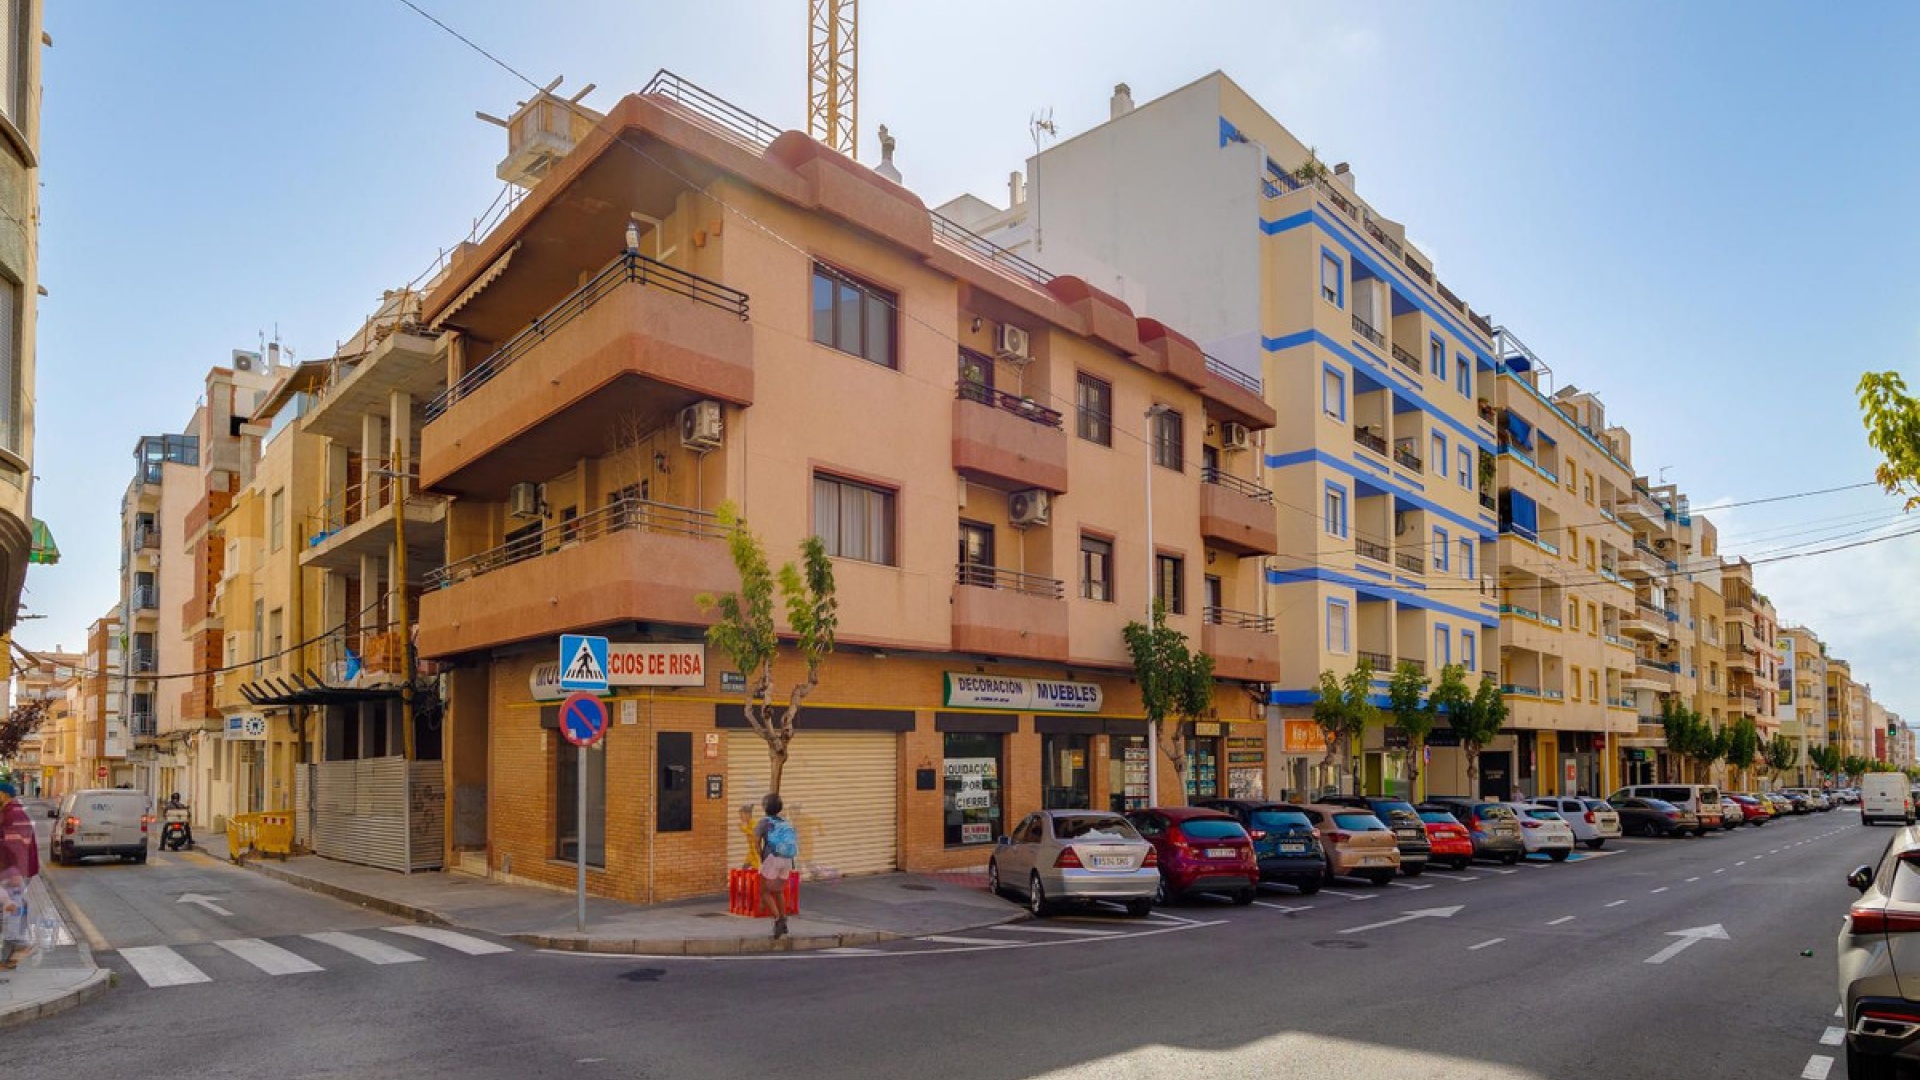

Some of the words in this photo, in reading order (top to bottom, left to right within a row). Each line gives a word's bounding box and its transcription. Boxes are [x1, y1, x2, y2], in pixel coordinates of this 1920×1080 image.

[648, 653, 665, 675] DE
[669, 653, 702, 675] RISA
[1037, 683, 1097, 703] MUEBLES
[962, 780, 982, 790] POR
[956, 796, 988, 810] CIERRE
